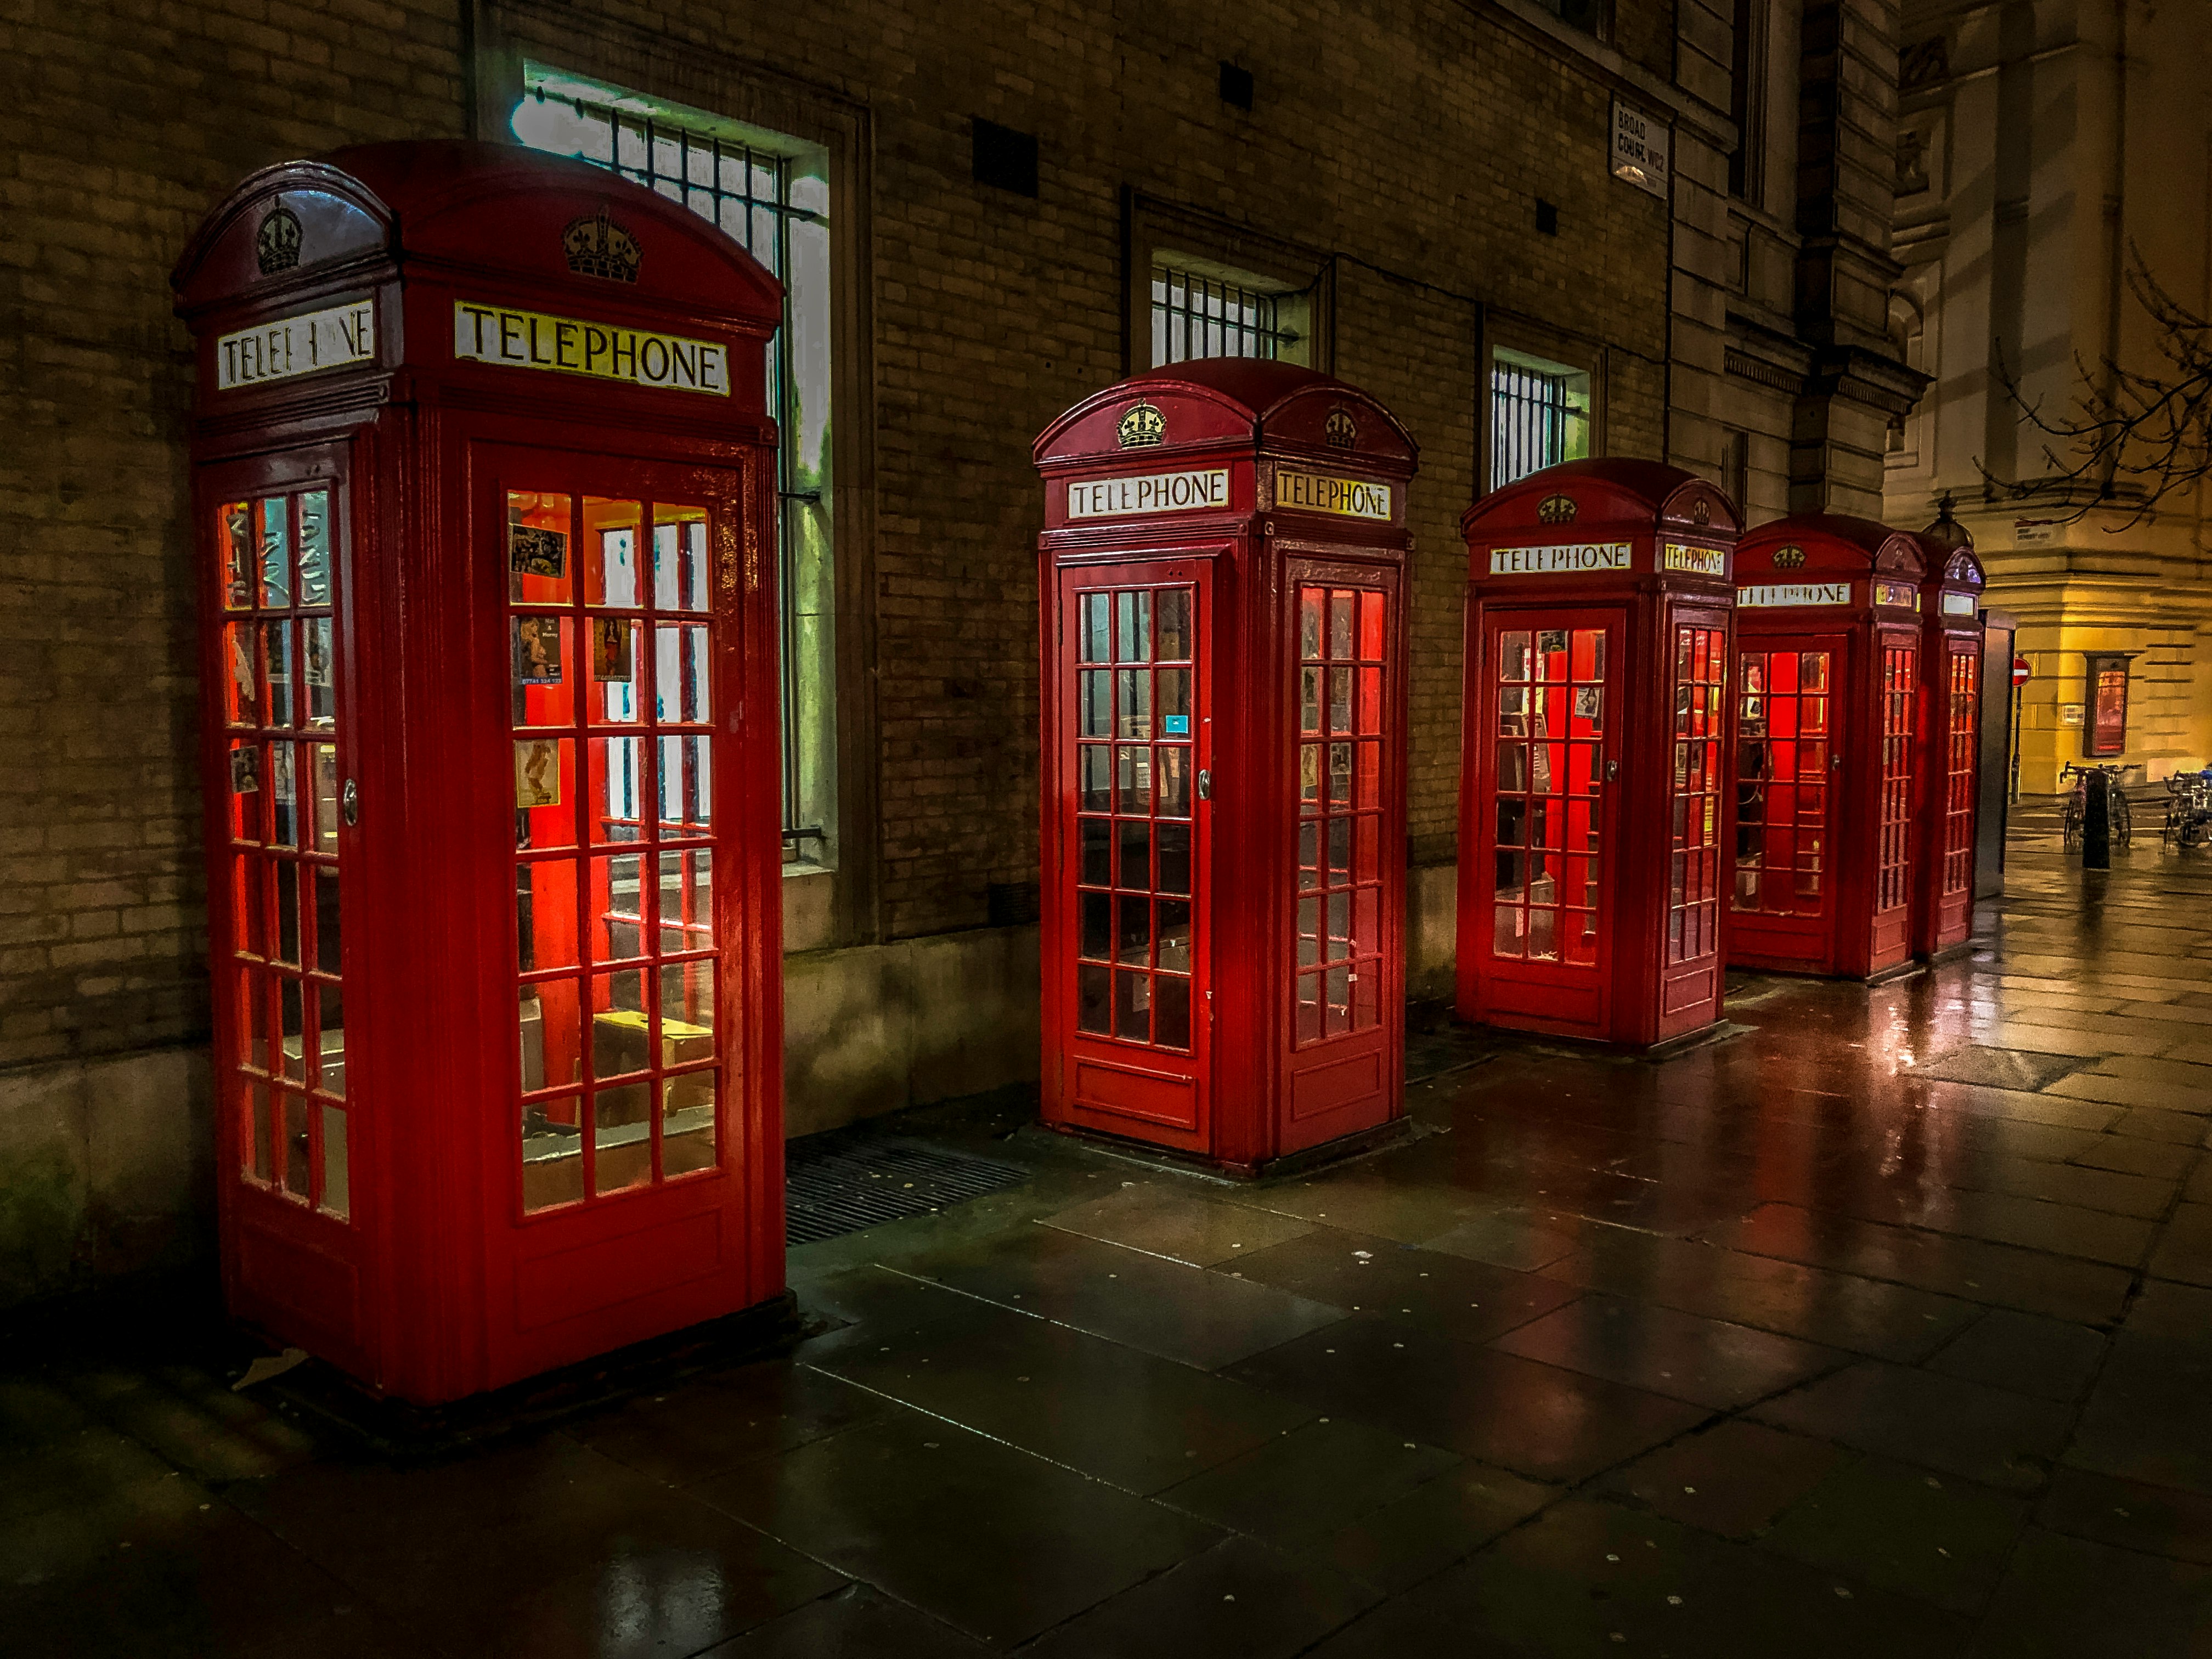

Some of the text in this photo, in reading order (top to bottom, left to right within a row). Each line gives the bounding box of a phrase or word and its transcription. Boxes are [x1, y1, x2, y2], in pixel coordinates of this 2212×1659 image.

[1618, 110, 1645, 140] BROAD
[462, 307, 720, 390] TELEPHONE
[1073, 472, 1224, 514] TELEPHONE
[1279, 472, 1386, 515] TELEPHONE
